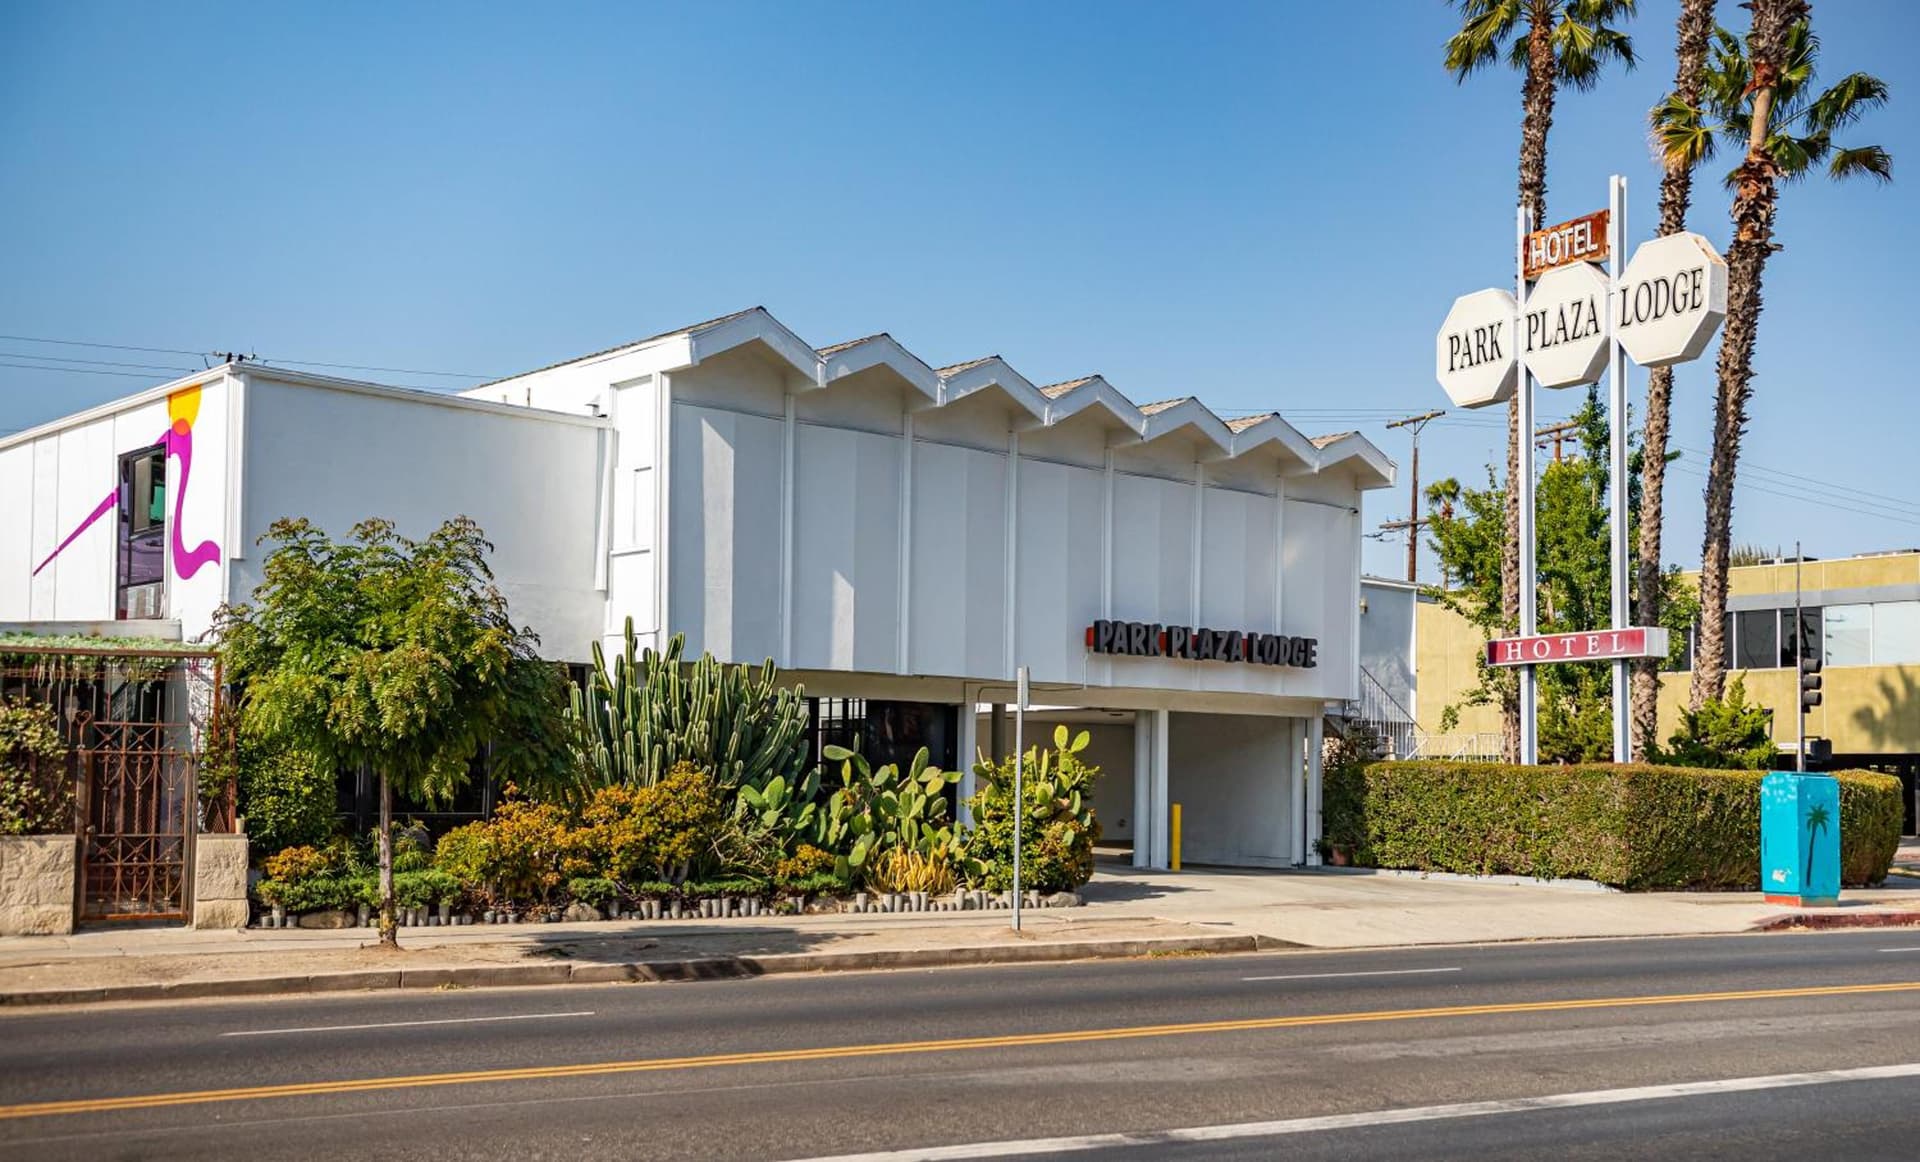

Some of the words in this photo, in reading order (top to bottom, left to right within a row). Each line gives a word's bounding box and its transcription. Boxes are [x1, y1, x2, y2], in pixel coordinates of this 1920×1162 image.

[1529, 221, 1598, 269] HOTEL
[1448, 321, 1503, 373] PARK
[1526, 294, 1600, 352] PLAZA
[1620, 268, 1705, 327] LODGE
[1094, 620, 1162, 656] PARK
[1166, 625, 1243, 662] PLAZA
[1247, 632, 1318, 668] LODGE
[1506, 633, 1625, 661] HOTEL
